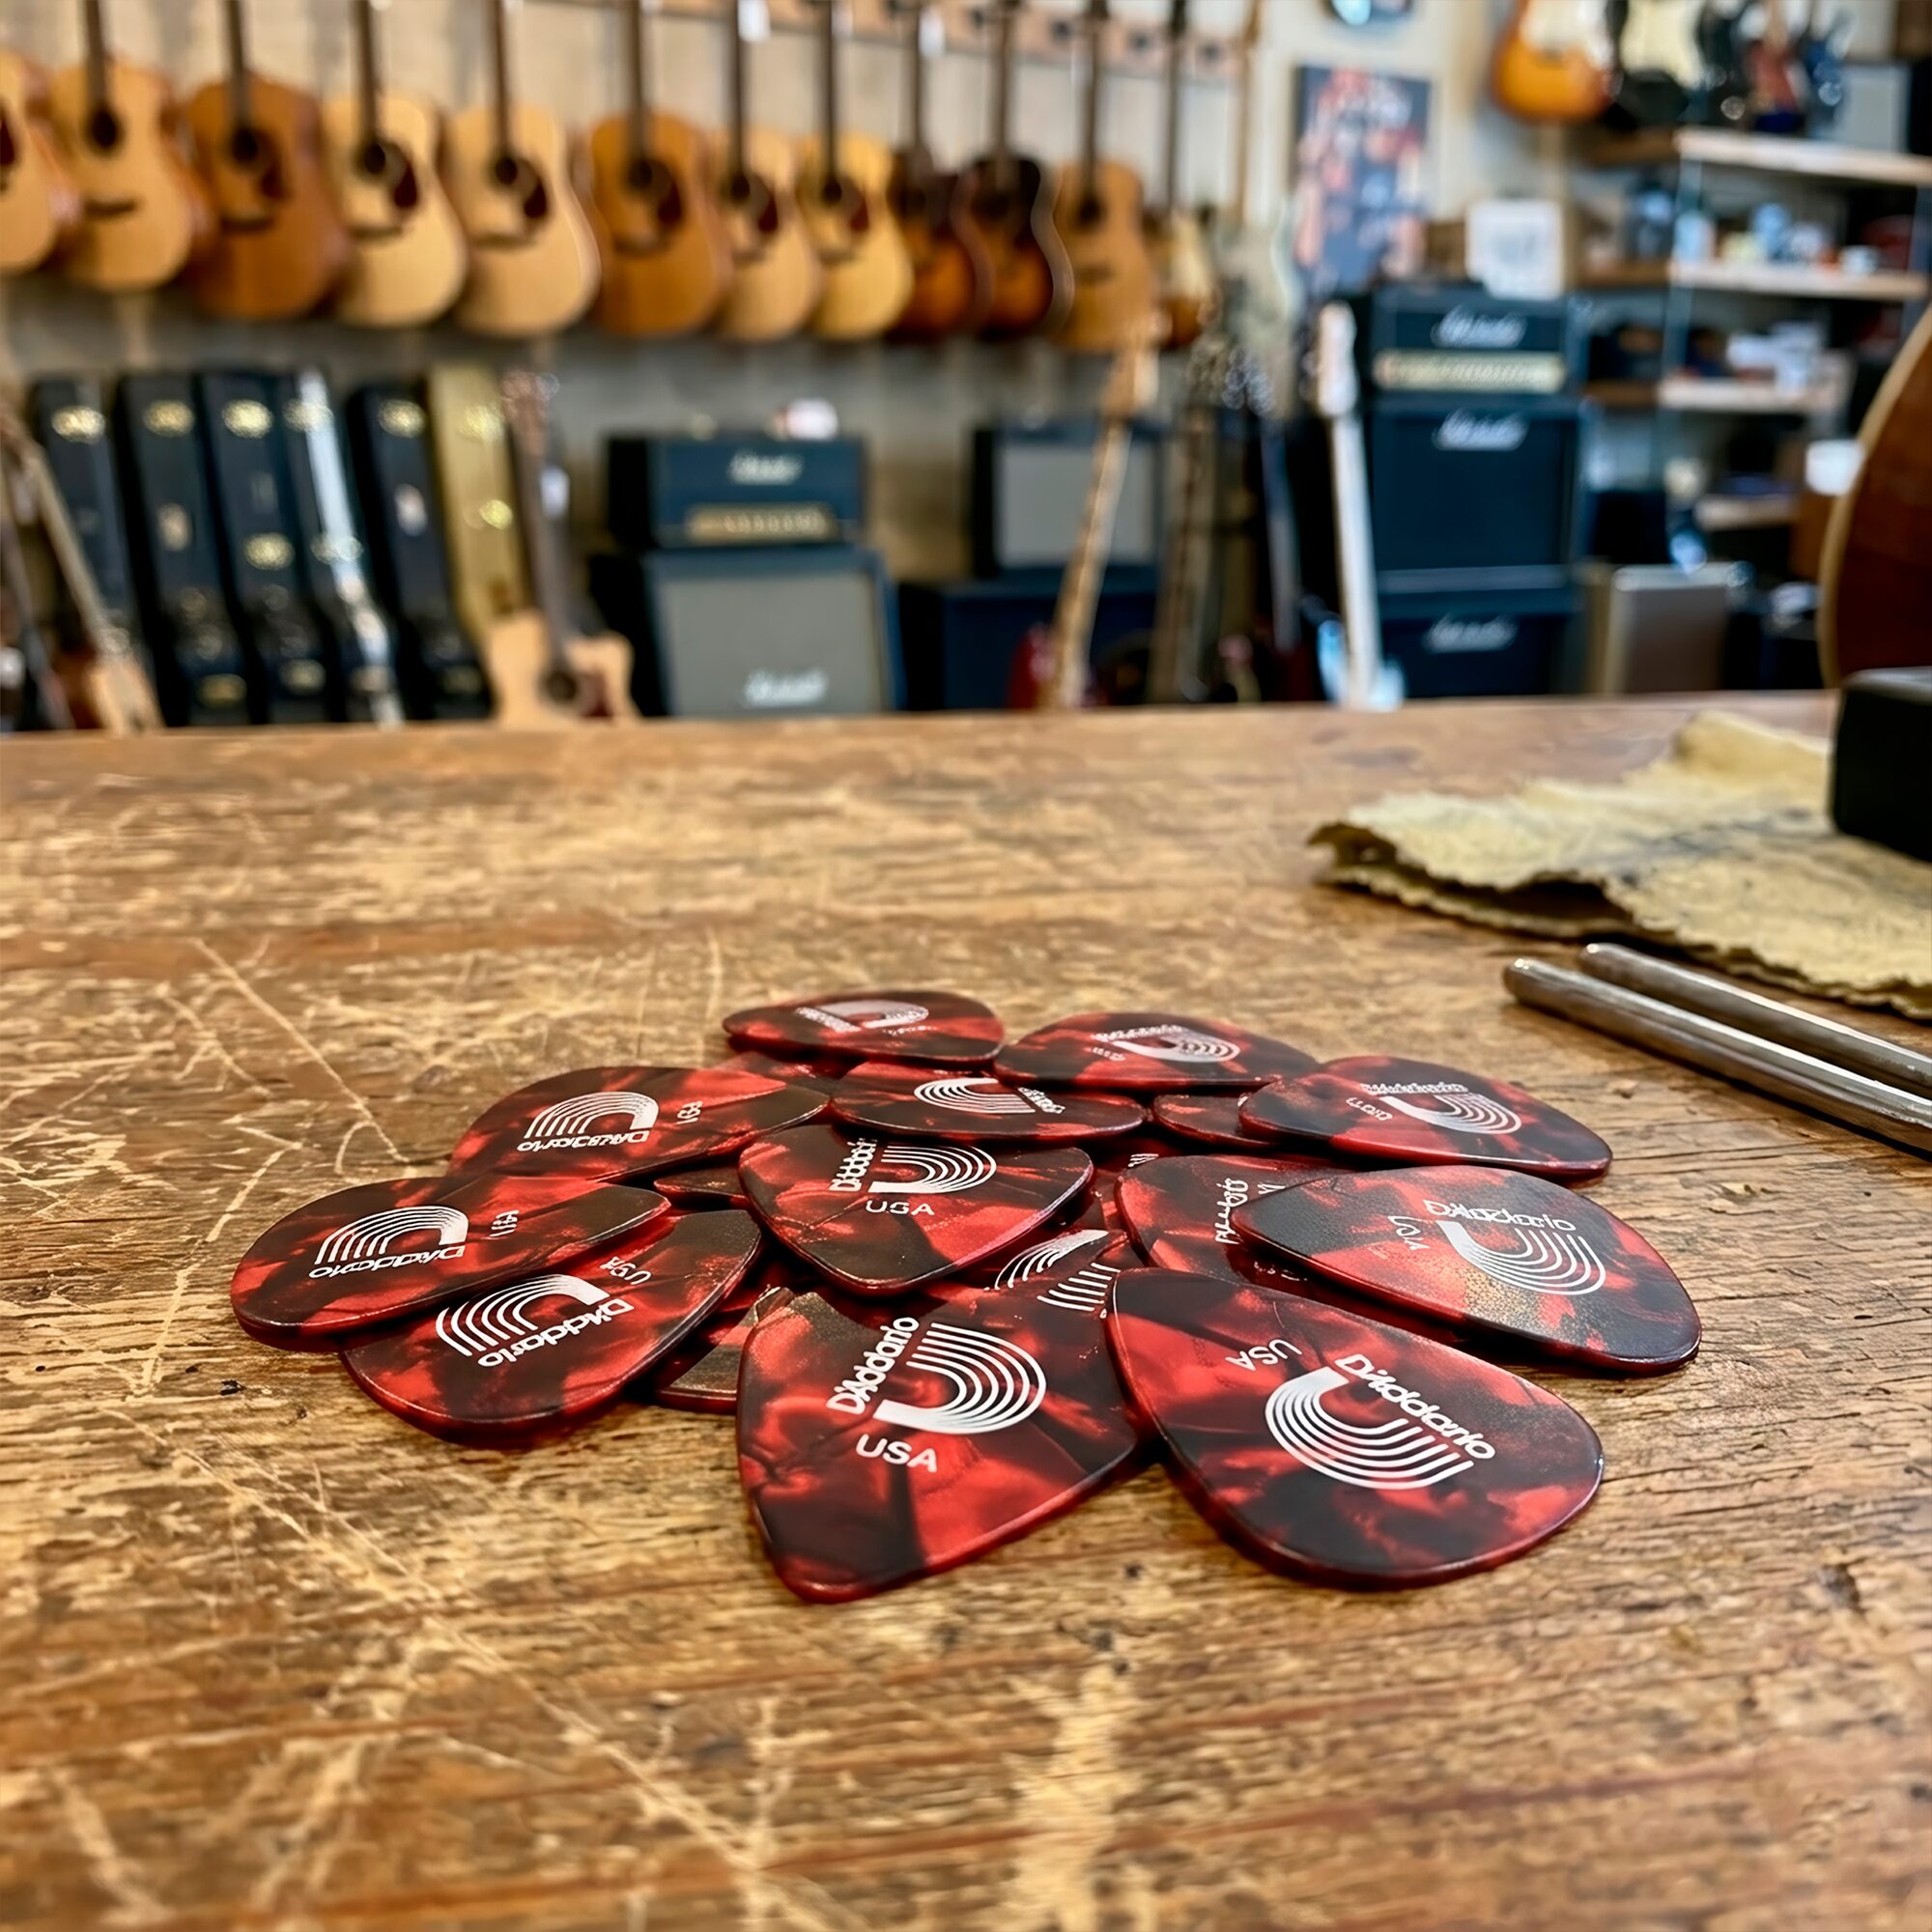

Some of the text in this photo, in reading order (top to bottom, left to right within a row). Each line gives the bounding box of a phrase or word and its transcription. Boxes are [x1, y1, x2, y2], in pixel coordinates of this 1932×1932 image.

[866, 1200, 935, 1216] USA
[825, 1317, 920, 1415] D'Addario
[1224, 1339, 1303, 1372] USA
[855, 1434, 938, 1473] USA
